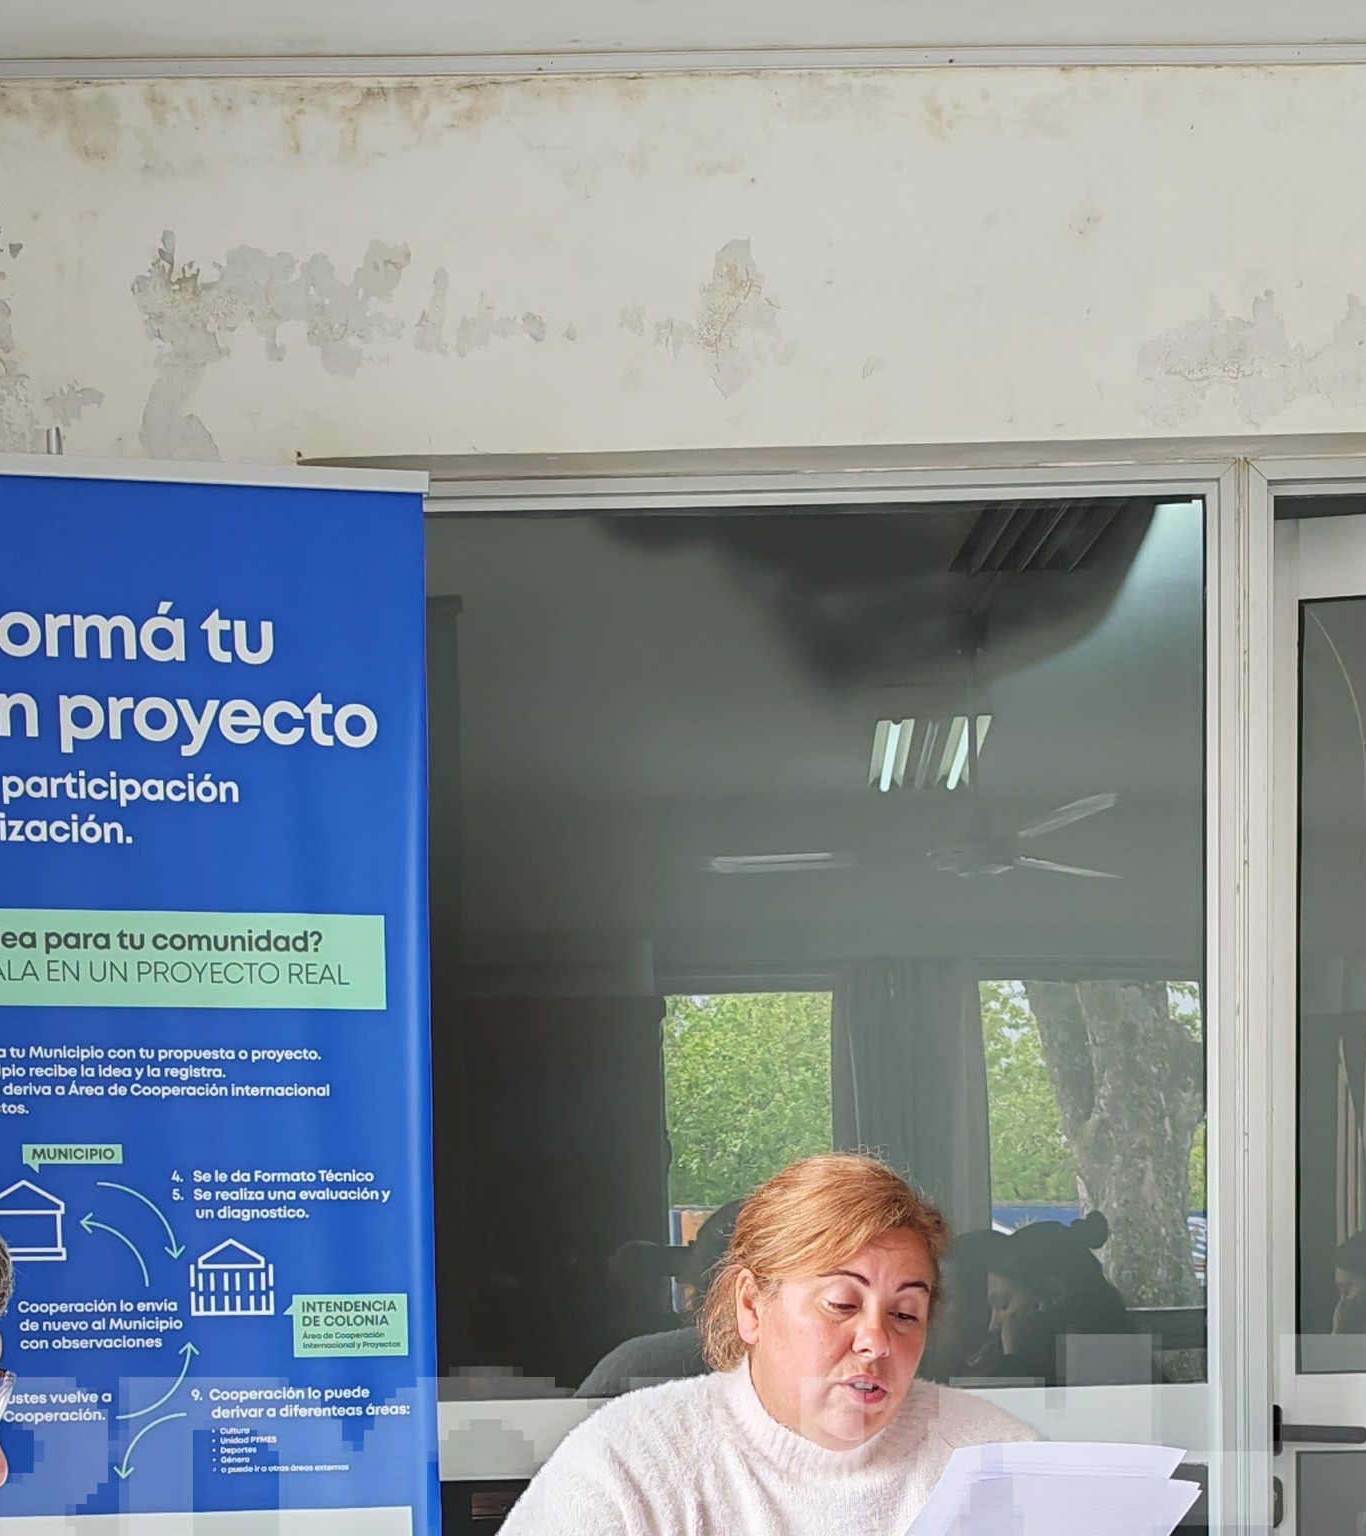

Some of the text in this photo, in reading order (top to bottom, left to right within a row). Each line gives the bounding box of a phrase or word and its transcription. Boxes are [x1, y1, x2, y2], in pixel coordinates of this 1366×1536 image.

[200, 608, 274, 665] tu
[58, 692, 378, 757] proyecto
[2, 770, 239, 807] participación
[44, 931, 111, 955] para
[116, 929, 145, 951] tu
[151, 929, 323, 953] comunidad?
[46, 959, 80, 982] EN
[89, 960, 128, 983] UN
[136, 960, 280, 985] PROYECTO
[288, 962, 350, 986] REAL
[9, 1046, 26, 1059] tu
[29, 1045, 105, 1062] Municipio
[107, 1048, 136, 1060] con
[138, 1047, 155, 1060] tu
[157, 1048, 236, 1062] propuesta
[237, 1049, 249, 1060] o
[251, 1048, 322, 1063] proyecto.
[29, 1063, 78, 1078] recibe
[80, 1064, 95, 1078] la
[98, 1064, 132, 1078] idea
[134, 1067, 145, 1081] y
[146, 1064, 161, 1078] la
[164, 1064, 227, 1081] registra.
[2, 1082, 52, 1096] deriva
[54, 1085, 66, 1096] a
[67, 1080, 105, 1096] Área
[107, 1083, 128, 1096] de
[130, 1083, 228, 1099] Cooperación
[231, 1083, 330, 1097] internacional
[31, 1147, 115, 1162] MUNICIPIO
[170, 1169, 375, 1183] 4. Se le da Formato Técnico
[172, 1186, 391, 1203] 5. Se realiza una evaluación y
[195, 1205, 310, 1222] un diagnostico.
[17, 1299, 117, 1316] Cooperación
[119, 1299, 134, 1312] lo
[136, 1298, 178, 1312] envía
[301, 1300, 398, 1313] INTENDENCIA
[19, 1316, 183, 1333] de nuevo al Municipio
[302, 1314, 390, 1327] DE COLONIA
[20, 1335, 163, 1350] con observaciones
[302, 1331, 386, 1341] Área de Cooperación
[302, 1341, 401, 1350] Internacional y Proyectos
[7, 1390, 112, 1405] ustes vuelve a
[190, 1385, 371, 1403] 9. Cooperación lo puede
[3, 1407, 106, 1425] Cooperación.
[211, 1403, 411, 1419] derivar a diferenteas áreas:
[219, 1427, 250, 1435] Cultura
[220, 1436, 249, 1444] Unidad
[220, 1446, 257, 1454] Deportes
[220, 1455, 250, 1463] Género
[227, 1465, 253, 1474] puede
[290, 1464, 313, 1472] áreas
